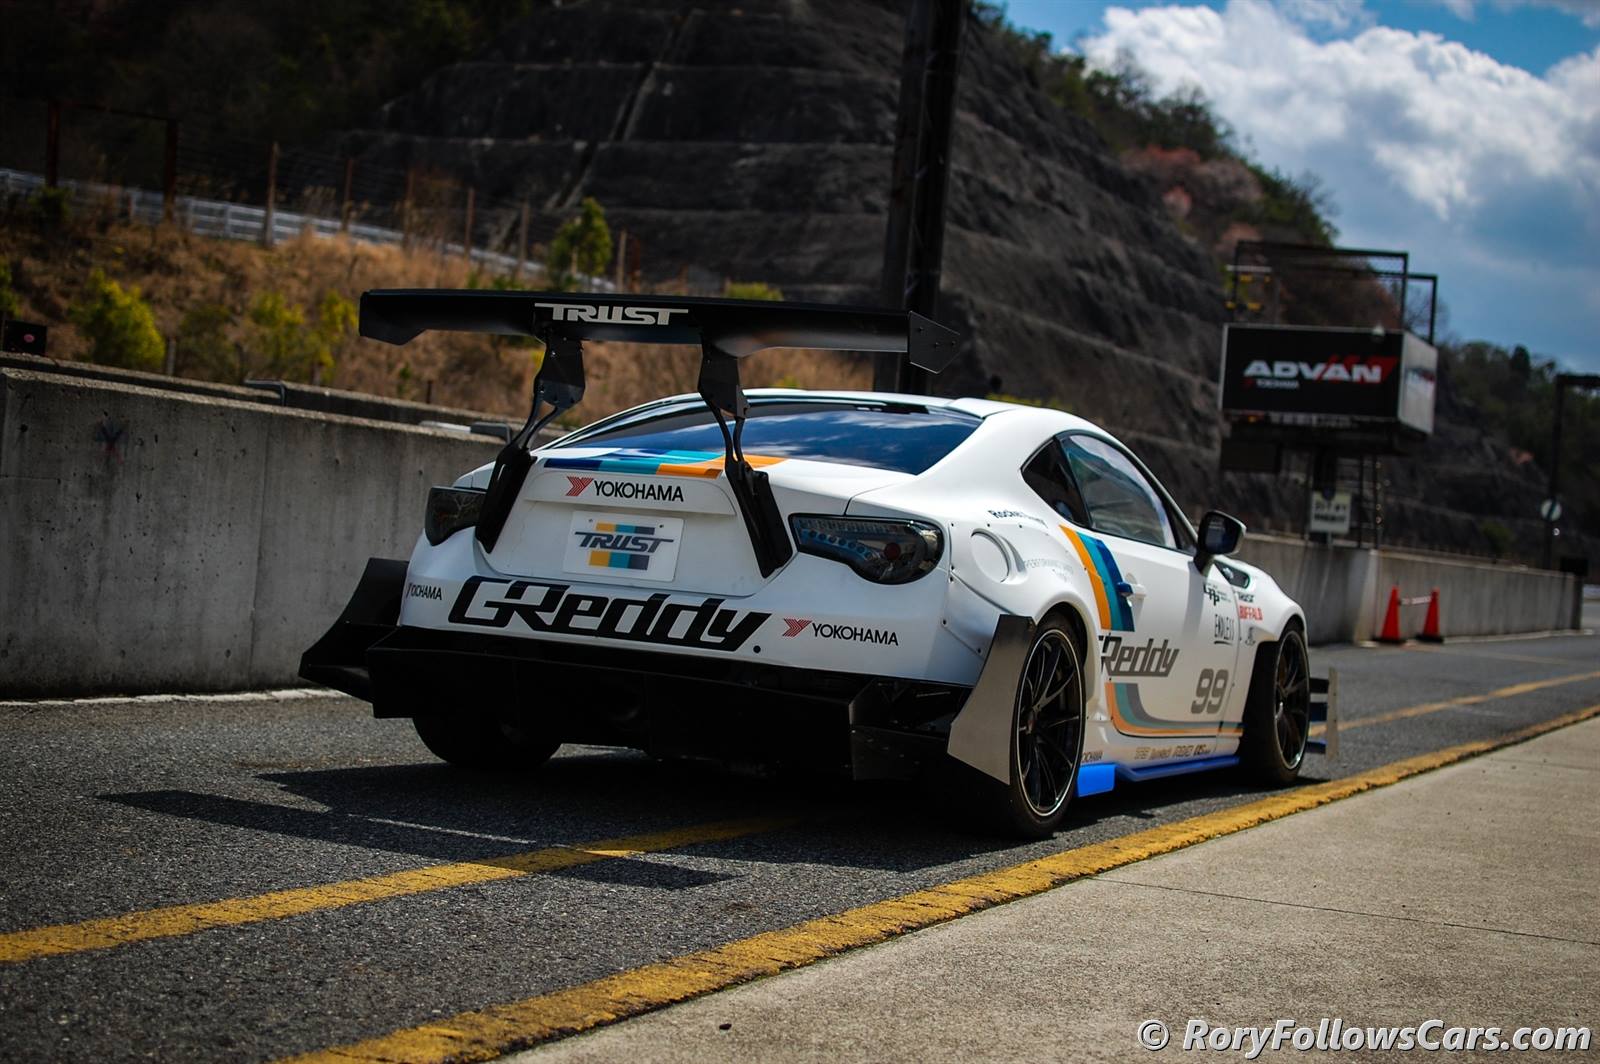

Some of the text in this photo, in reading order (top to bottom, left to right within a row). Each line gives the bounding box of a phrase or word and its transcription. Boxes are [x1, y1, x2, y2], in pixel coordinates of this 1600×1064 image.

[535, 303, 689, 326] TRUST
[1243, 359, 1383, 384] ADVAN
[594, 480, 684, 502] YOKOHAMA
[574, 531, 674, 553] TRUST
[812, 622, 899, 647] YOKOHAMA
[1098, 635, 1180, 677] Reddy
[1191, 668, 1229, 714] 99
